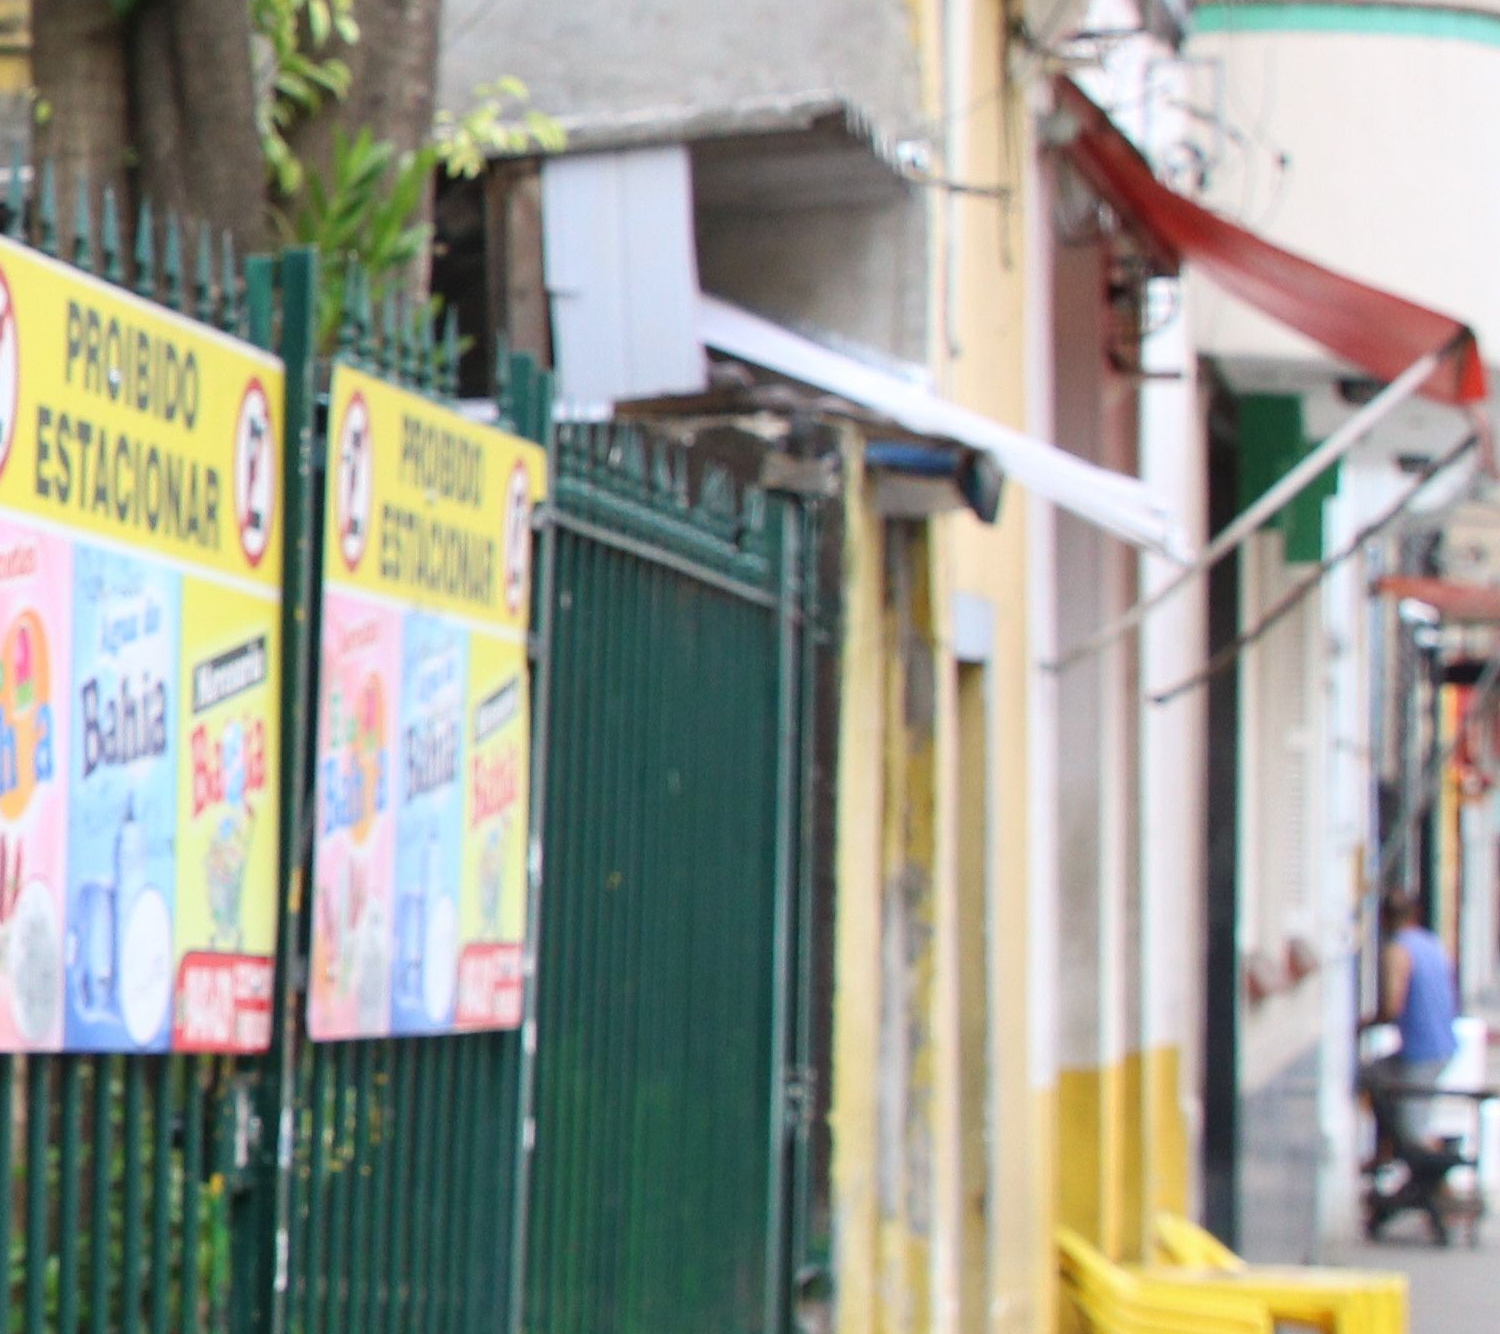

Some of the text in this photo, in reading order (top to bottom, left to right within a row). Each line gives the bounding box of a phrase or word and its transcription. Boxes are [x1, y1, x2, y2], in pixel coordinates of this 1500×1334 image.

[65, 298, 200, 432] PROIBIDO
[35, 404, 221, 550] ESTACIONAR
[82, 670, 168, 781] Bahia
